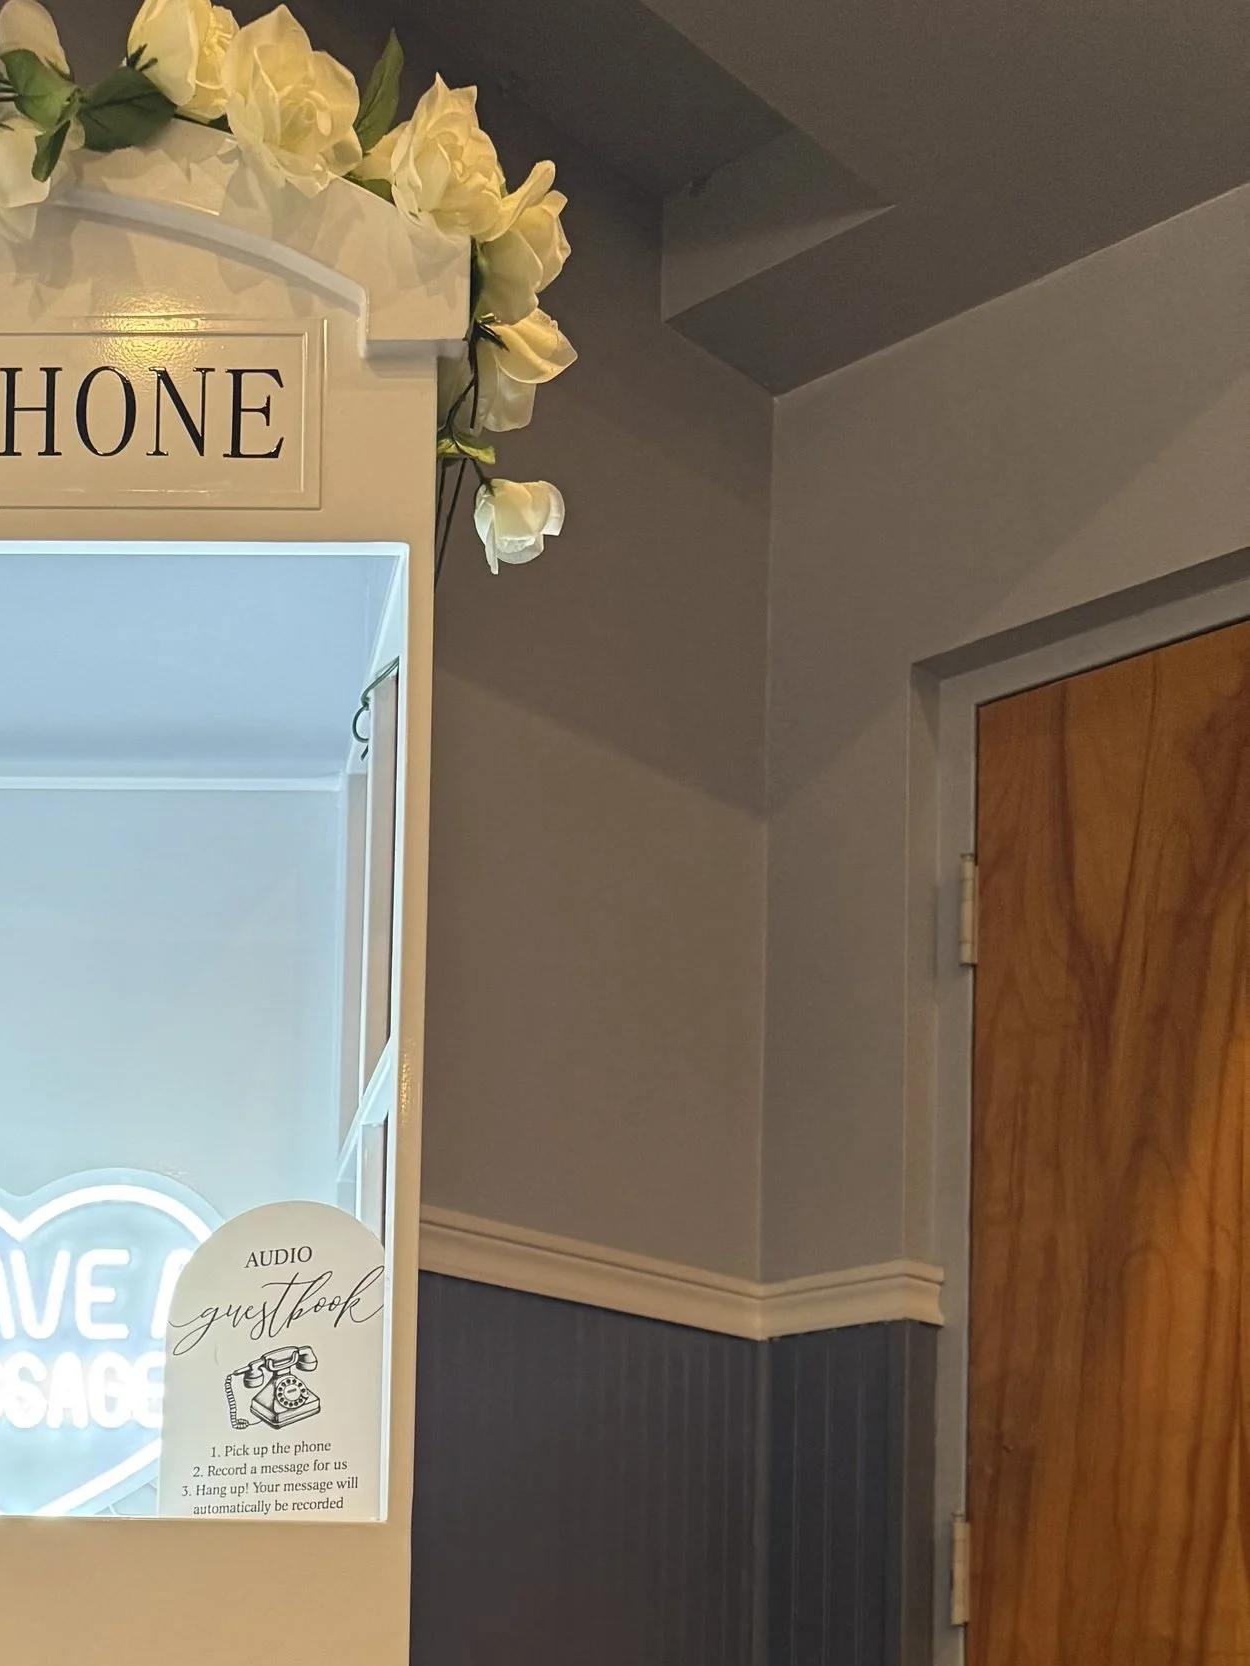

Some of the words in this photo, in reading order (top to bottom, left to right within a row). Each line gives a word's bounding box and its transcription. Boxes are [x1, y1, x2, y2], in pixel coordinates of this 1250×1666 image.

[245, 1245, 313, 1269] AUDIO
[167, 1265, 385, 1356] guestbook
[211, 1446, 221, 1457] 1.
[224, 1444, 250, 1458] Pick
[253, 1446, 269, 1458] up
[271, 1442, 291, 1455] the
[294, 1441, 331, 1456] phone
[193, 1466, 204, 1478] 2.
[207, 1463, 247, 1477] Record
[250, 1466, 258, 1475] a
[260, 1461, 310, 1475] message
[313, 1459, 330, 1472] for
[334, 1460, 348, 1470] us
[181, 1485, 192, 1497] 3.
[196, 1484, 227, 1498] Hang
[230, 1483, 249, 1498] up!
[253, 1481, 280, 1494] Your
[283, 1480, 333, 1494] message
[336, 1476, 359, 1489] will
[193, 1499, 271, 1515] automatically
[274, 1499, 289, 1512] be
[292, 1496, 344, 1511] recorded
